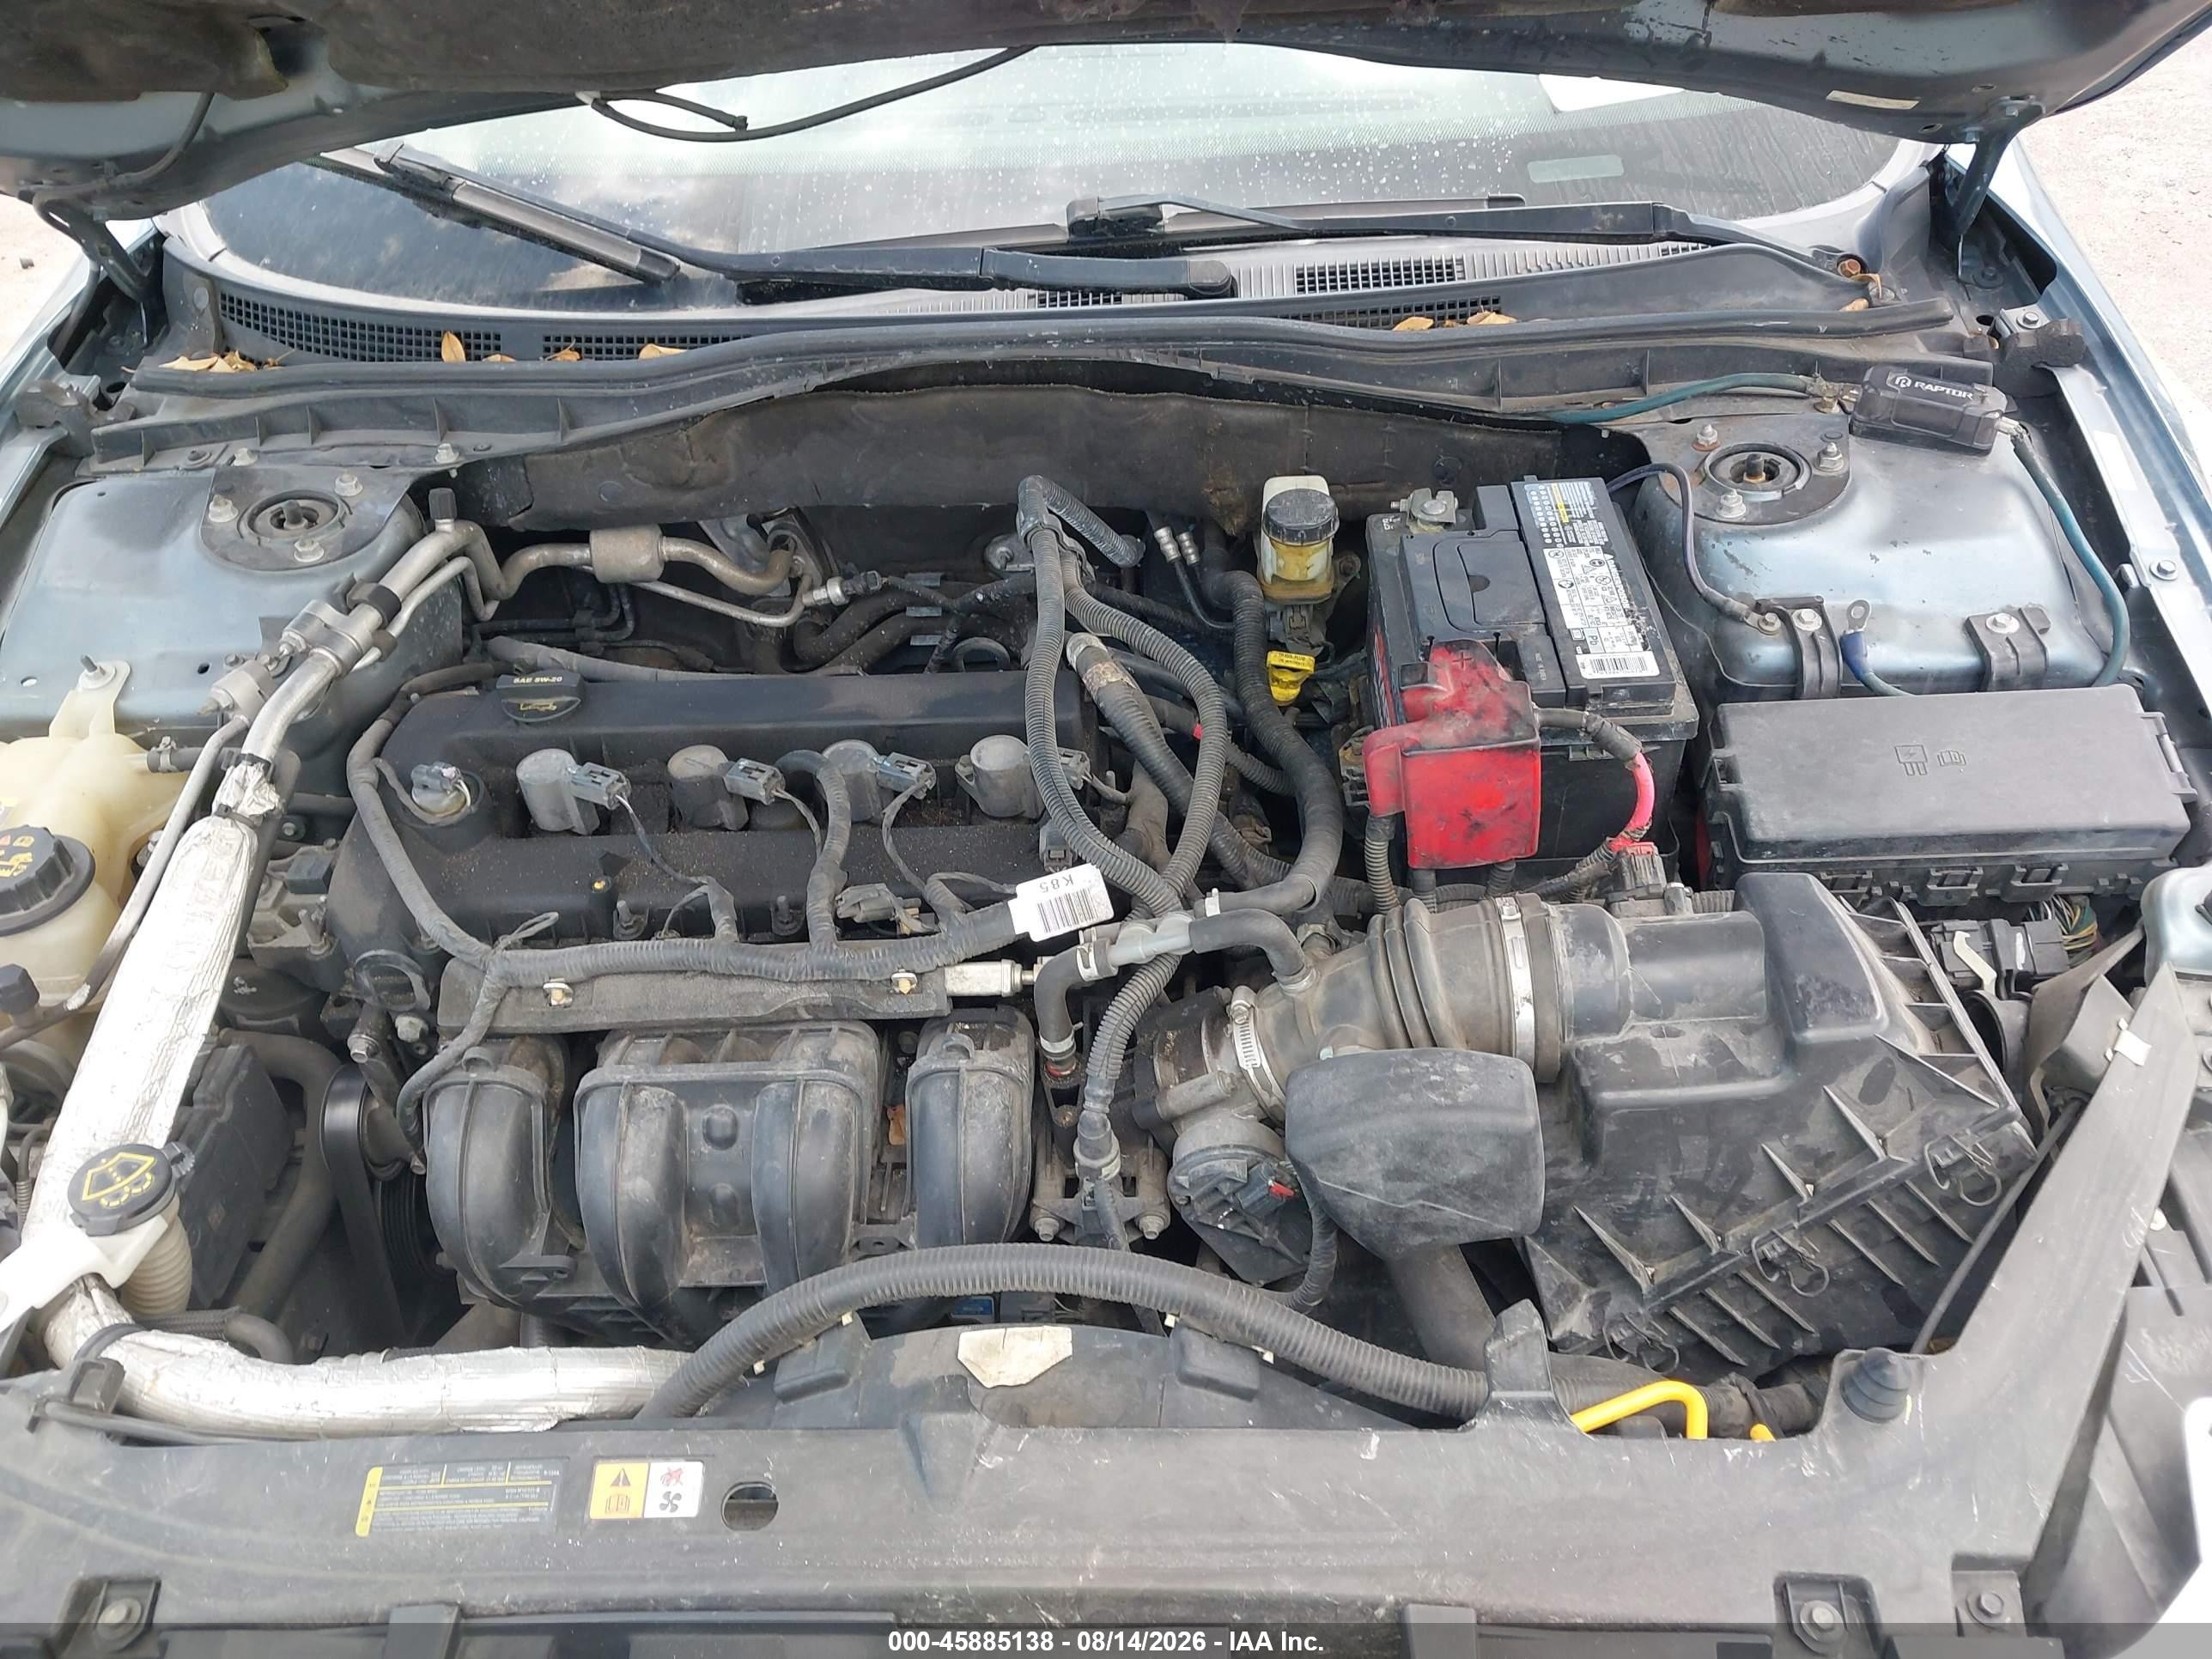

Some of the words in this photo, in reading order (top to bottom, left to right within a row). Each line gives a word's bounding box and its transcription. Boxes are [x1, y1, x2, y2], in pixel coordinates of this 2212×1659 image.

[1914, 380, 1974, 399] RAPTOR
[1589, 635, 1599, 646] Pb
[1039, 874, 1074, 893] K85
